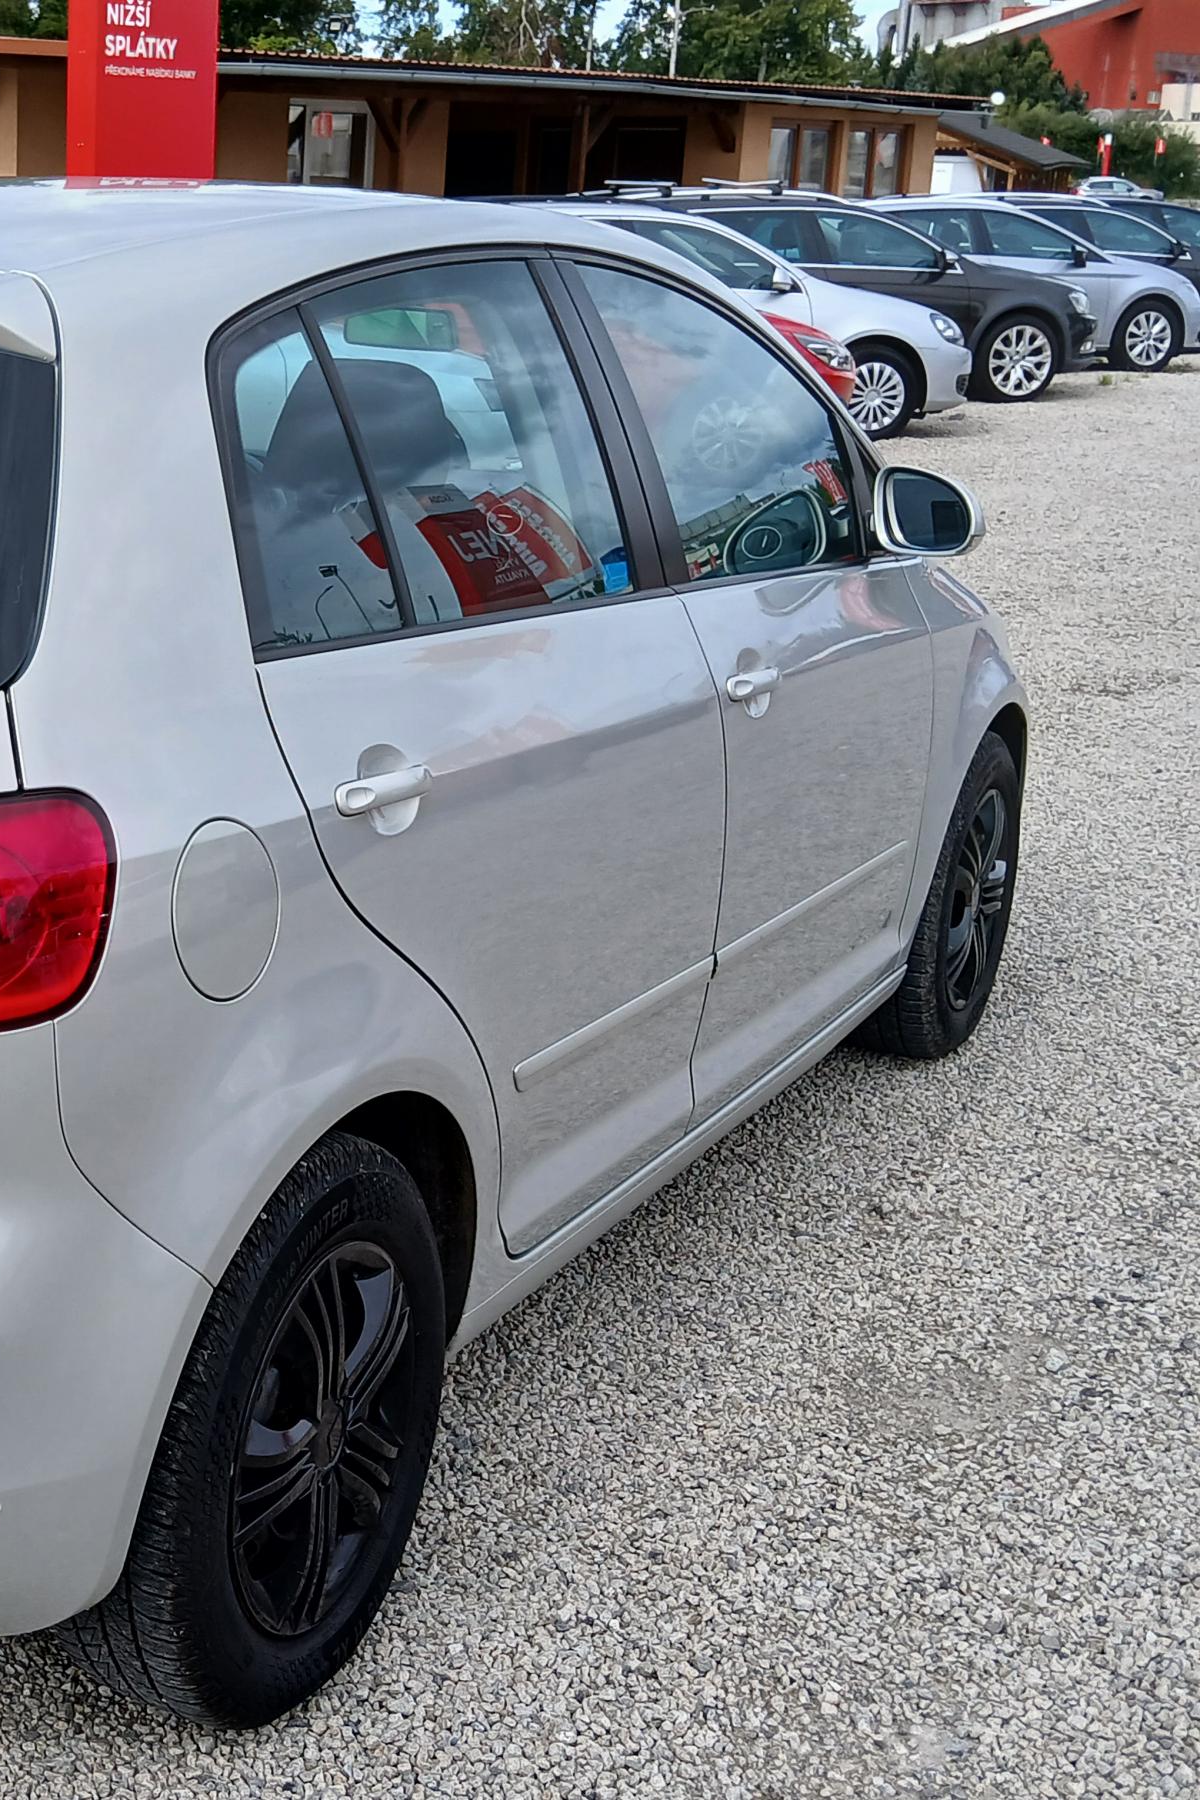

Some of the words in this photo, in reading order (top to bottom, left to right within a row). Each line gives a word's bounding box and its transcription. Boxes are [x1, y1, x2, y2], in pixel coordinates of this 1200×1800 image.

[106, 0, 151, 28] NIŽŠÍ
[104, 31, 178, 60] SPLÁTKY
[295, 1197, 350, 1262] WINTER
